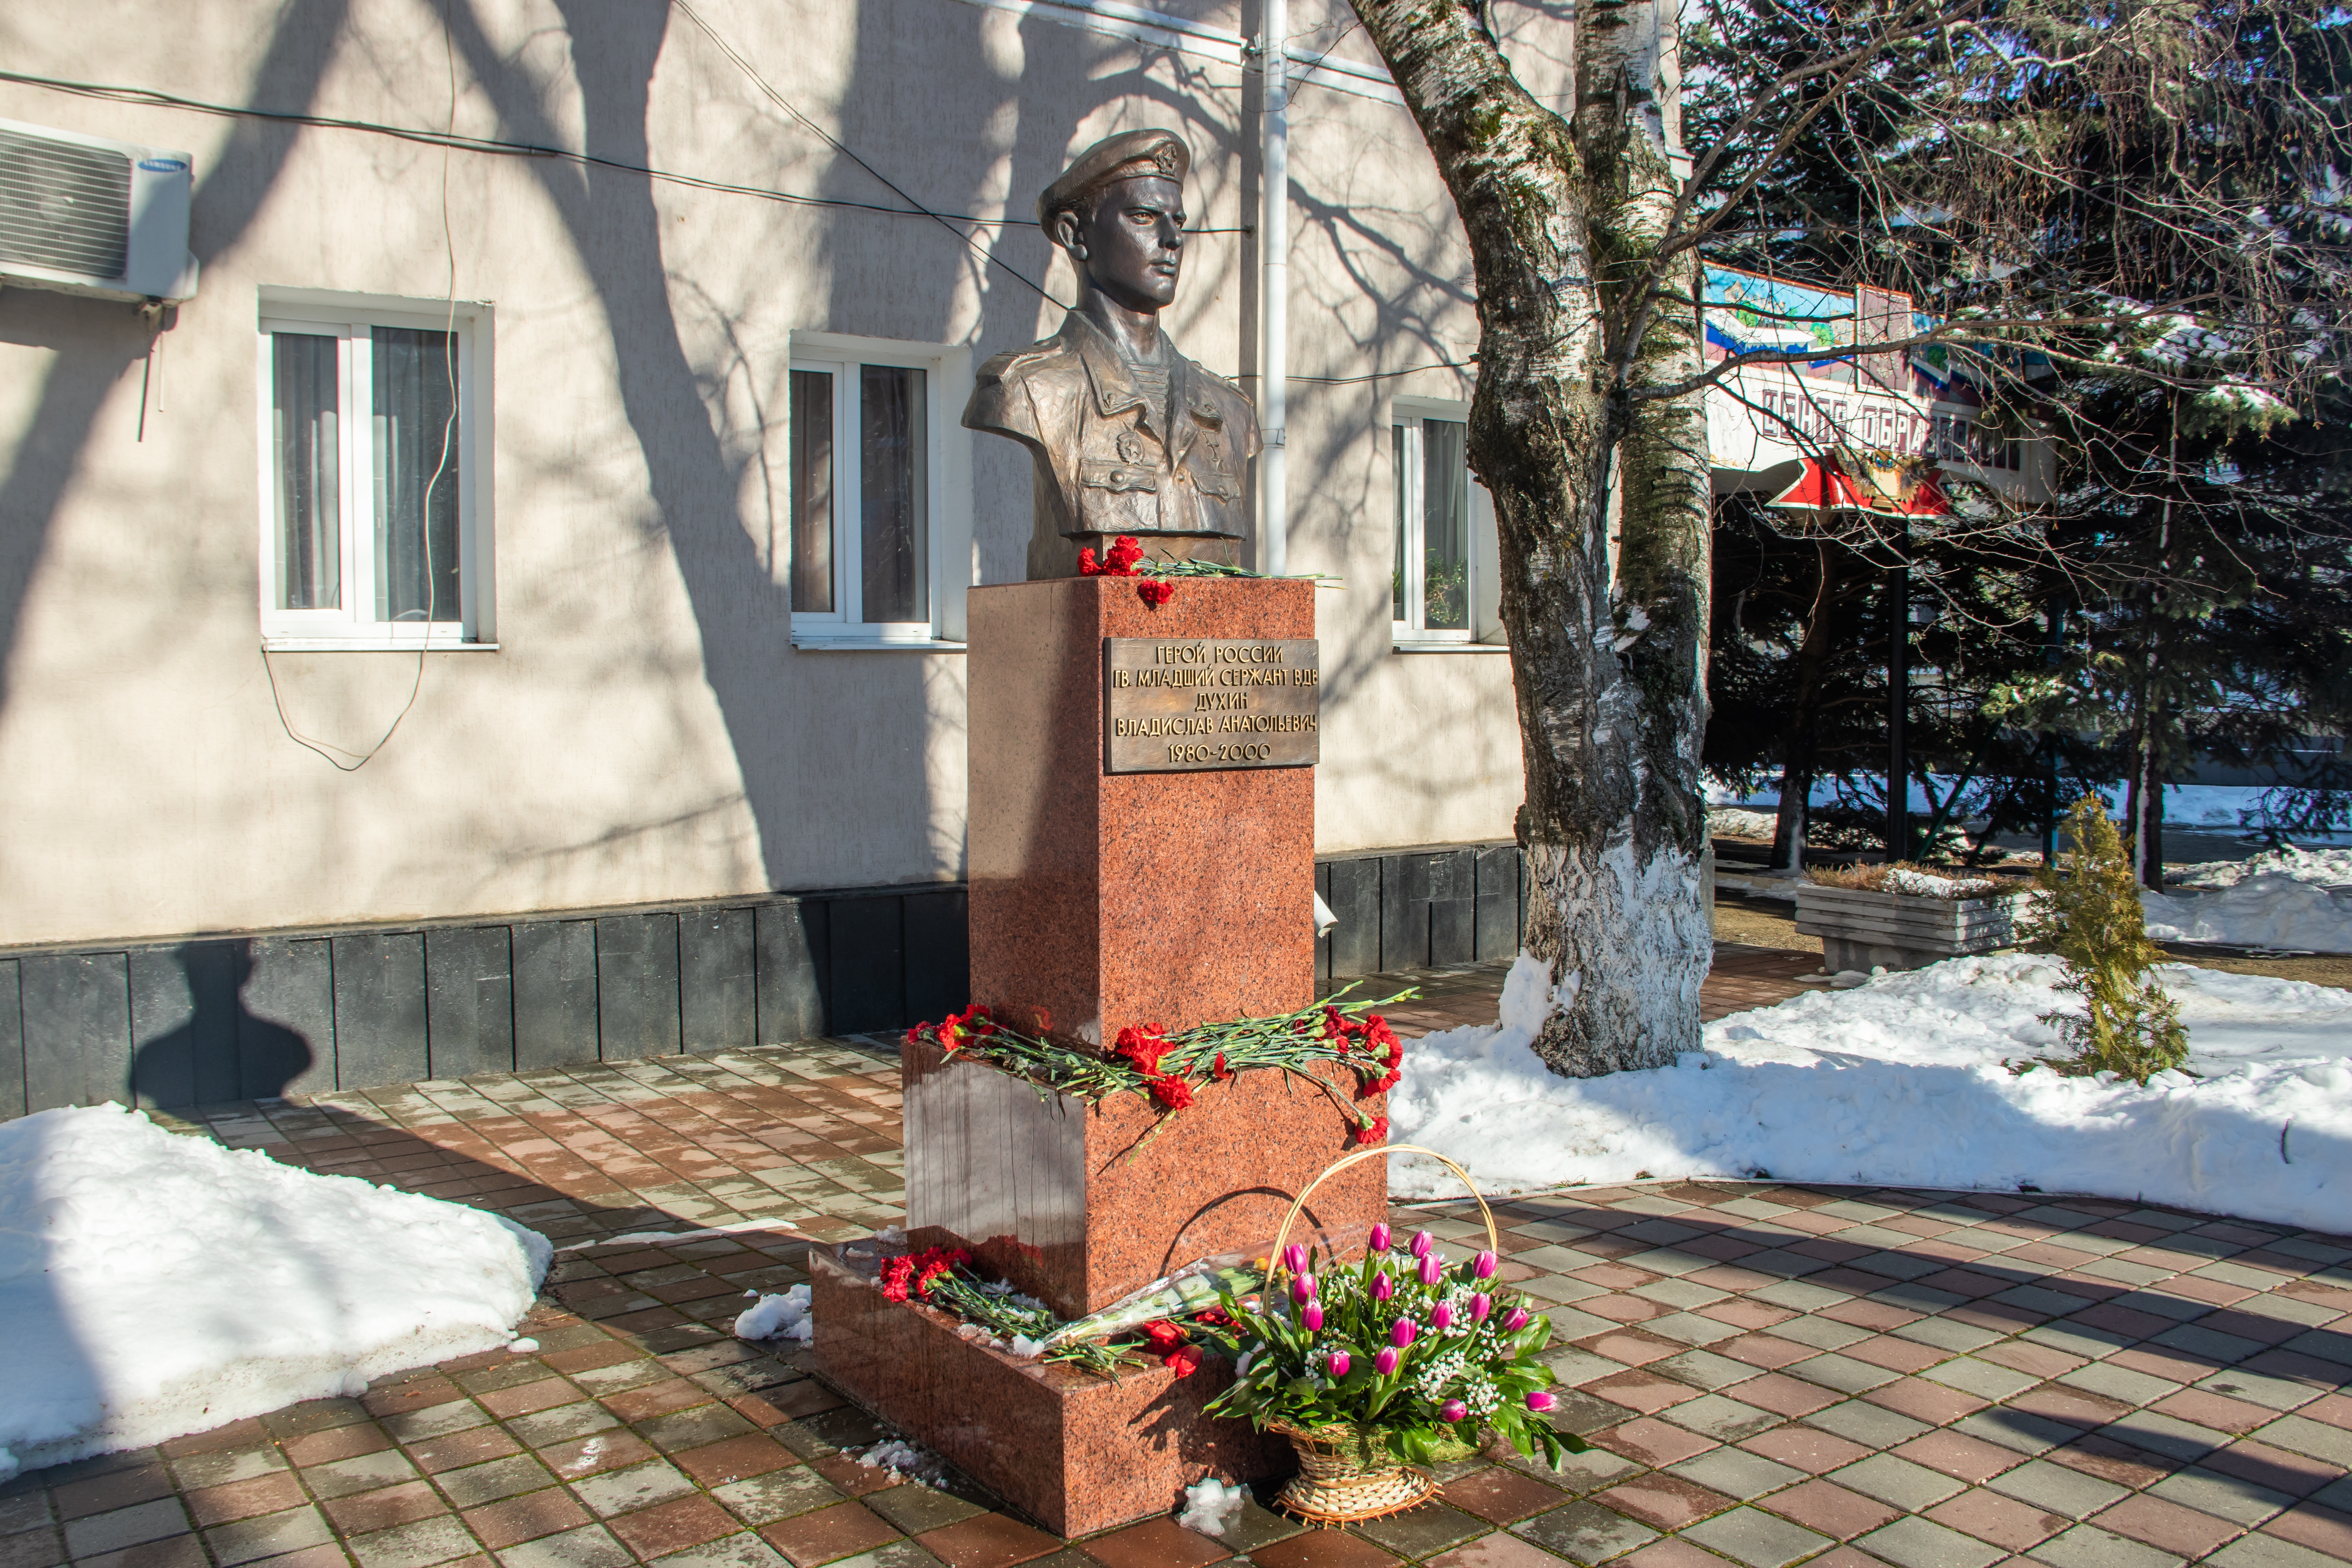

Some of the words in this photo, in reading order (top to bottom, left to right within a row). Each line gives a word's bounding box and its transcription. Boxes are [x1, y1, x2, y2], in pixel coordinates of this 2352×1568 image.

[1156, 642, 1206, 664] ГЕРОЙ
[1215, 646, 1283, 663] РОССИИ
[1113, 669, 1131, 688] ГВ.
[1138, 664, 1215, 688] МЛАДШИЙ
[1220, 668, 1289, 686] СЕРЖАНТ
[1293, 668, 1318, 686] ВДВ
[1195, 692, 1247, 711] ДУХИН
[1116, 717, 1214, 736] ВЛАДИСЛАВ
[1219, 714, 1317, 733] АНАТОЛЬЕВИЧ
[1168, 743, 1271, 762] 1980-2000
